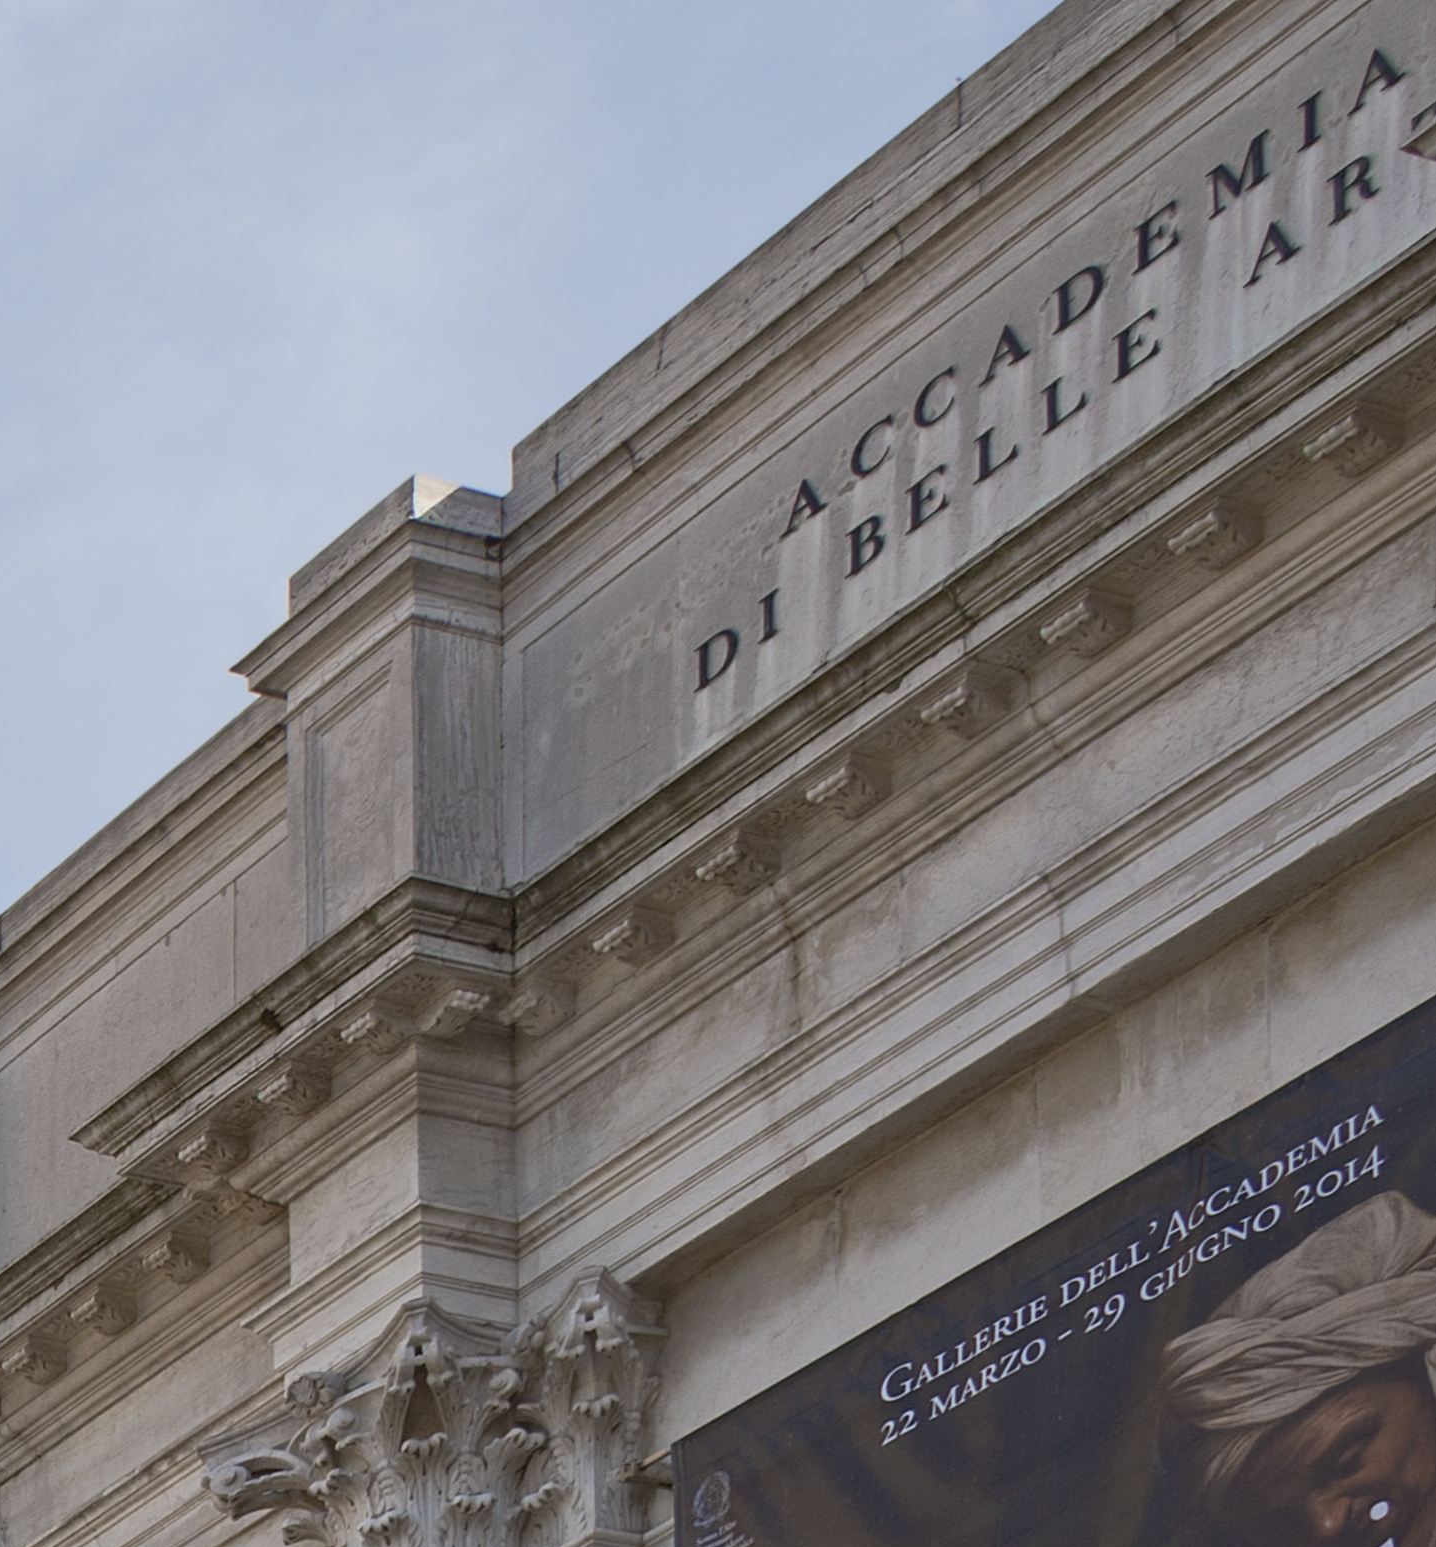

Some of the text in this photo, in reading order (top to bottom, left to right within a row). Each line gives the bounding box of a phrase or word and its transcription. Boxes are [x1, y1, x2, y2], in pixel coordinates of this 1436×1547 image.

[694, 101, 1436, 692] DI BELLE AR
[780, 48, 1407, 539] ACCADEMIA
[879, 1408, 918, 1447] 22
[926, 1336, 1048, 1424] MARZO
[1081, 1292, 1126, 1335] 29
[1137, 1203, 1281, 1303] GIUGNO
[1293, 1145, 1387, 1214] 2014
[879, 1295, 1048, 1404] GALLERIE
